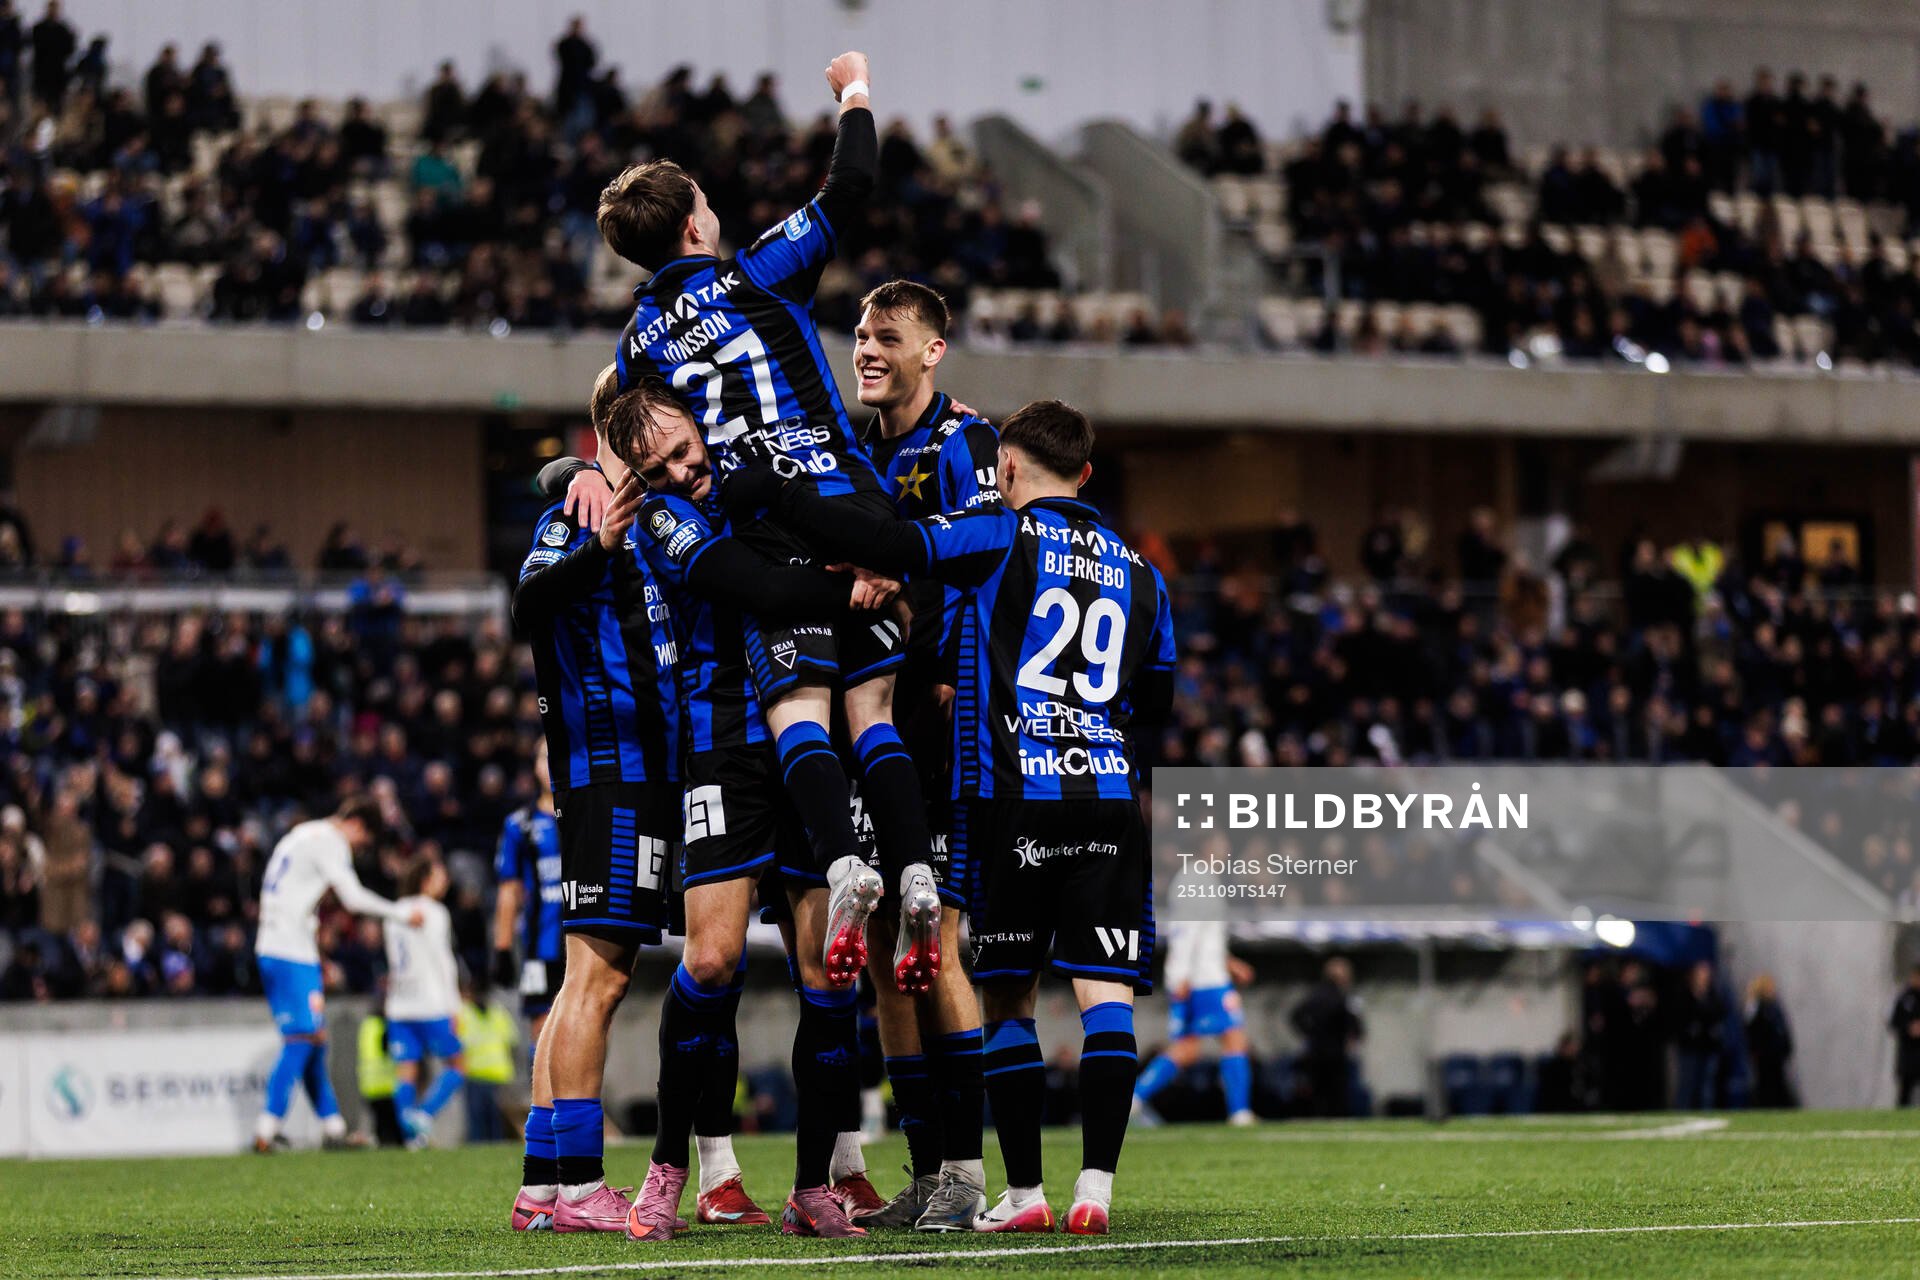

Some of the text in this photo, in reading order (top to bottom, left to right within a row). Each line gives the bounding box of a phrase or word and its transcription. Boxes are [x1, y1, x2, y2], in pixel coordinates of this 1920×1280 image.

[630, 272, 740, 359] ÅRSTA TAK
[663, 310, 732, 365] JÖNSSON
[672, 328, 779, 444] 27
[531, 549, 564, 562] NIBE
[666, 523, 698, 557] UNIBET
[1021, 515, 1144, 567] ÅRSTA TAK
[1044, 550, 1125, 589] BJERKEBO
[771, 640, 795, 654] TEAM
[1017, 587, 1126, 702] 29
[1004, 715, 1125, 742] WELLNESS
[1022, 701, 1104, 729] NORDIC
[1018, 747, 1130, 775] inkClub
[578, 883, 603, 894] Vaksala
